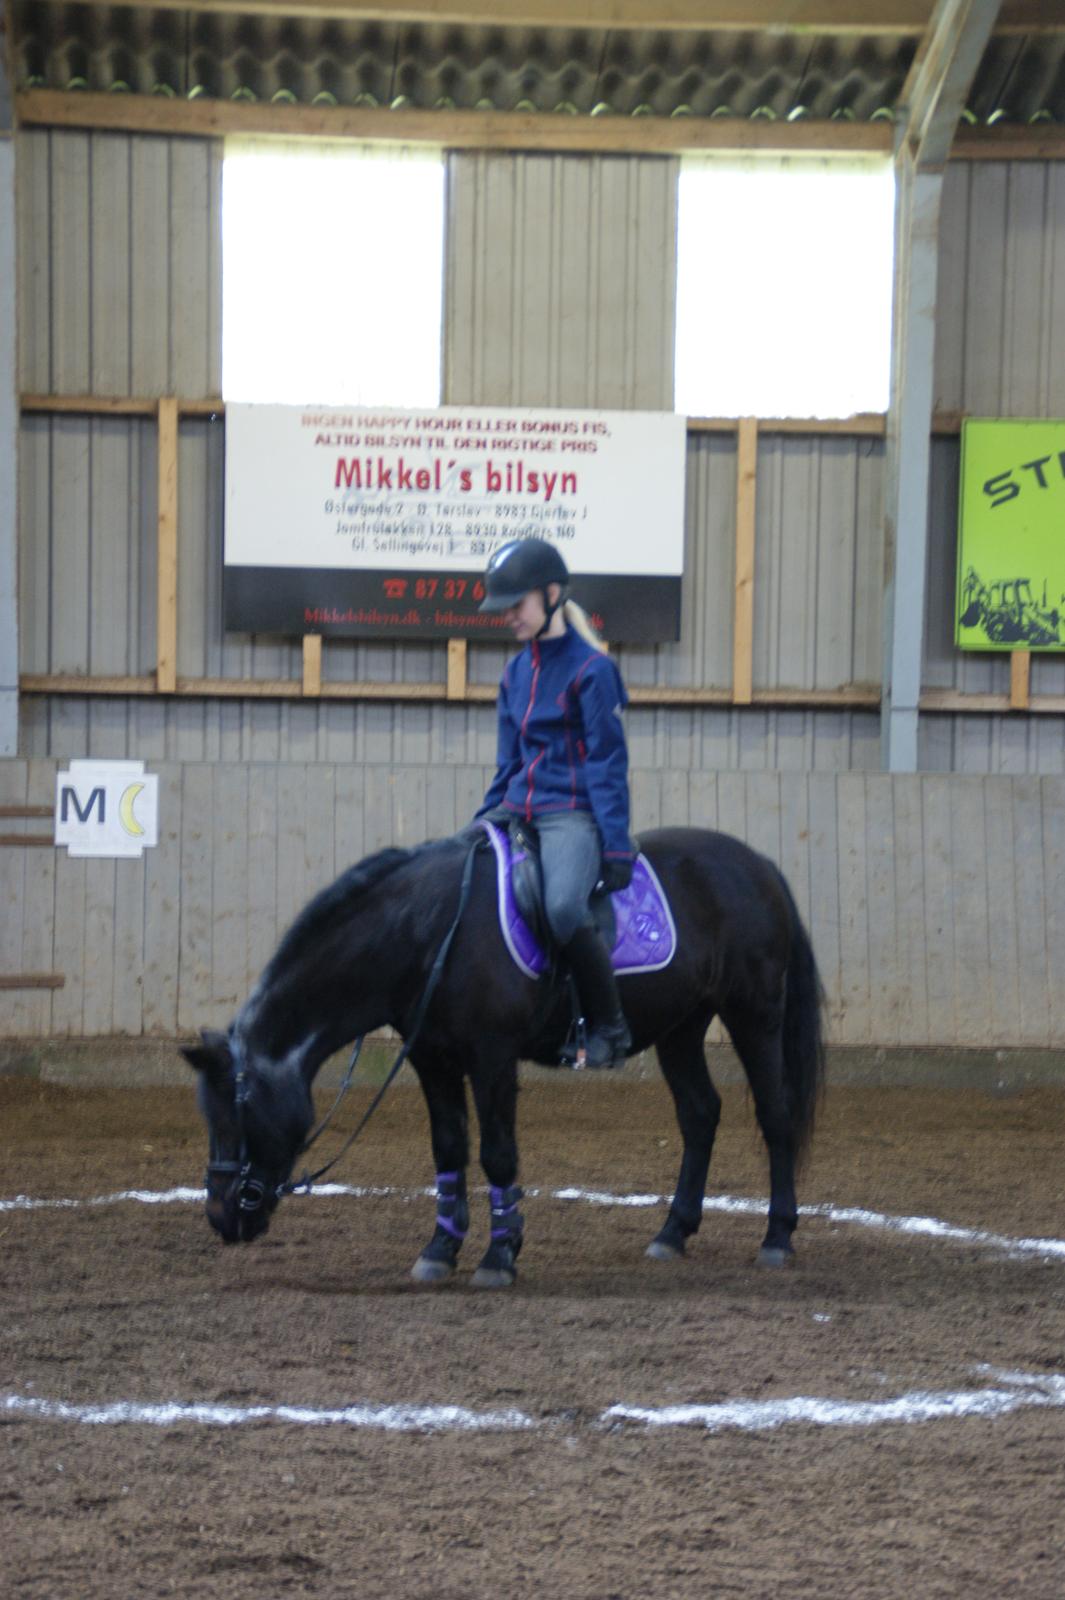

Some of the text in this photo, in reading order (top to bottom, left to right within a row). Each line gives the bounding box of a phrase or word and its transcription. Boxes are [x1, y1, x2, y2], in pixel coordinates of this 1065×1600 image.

[302, 414, 353, 428] INGEN
[358, 416, 411, 430] HAPPY
[415, 417, 462, 431] HOUR
[467, 419, 517, 432] ELLER
[521, 421, 579, 434] BONUS
[315, 432, 599, 453] ALTID BILSYN TIL DEN RIGTIGE PRIS
[486, 459, 577, 502] bilsyn
[415, 577, 439, 600] 87
[443, 578, 468, 600] 37
[61, 787, 106, 823] M
